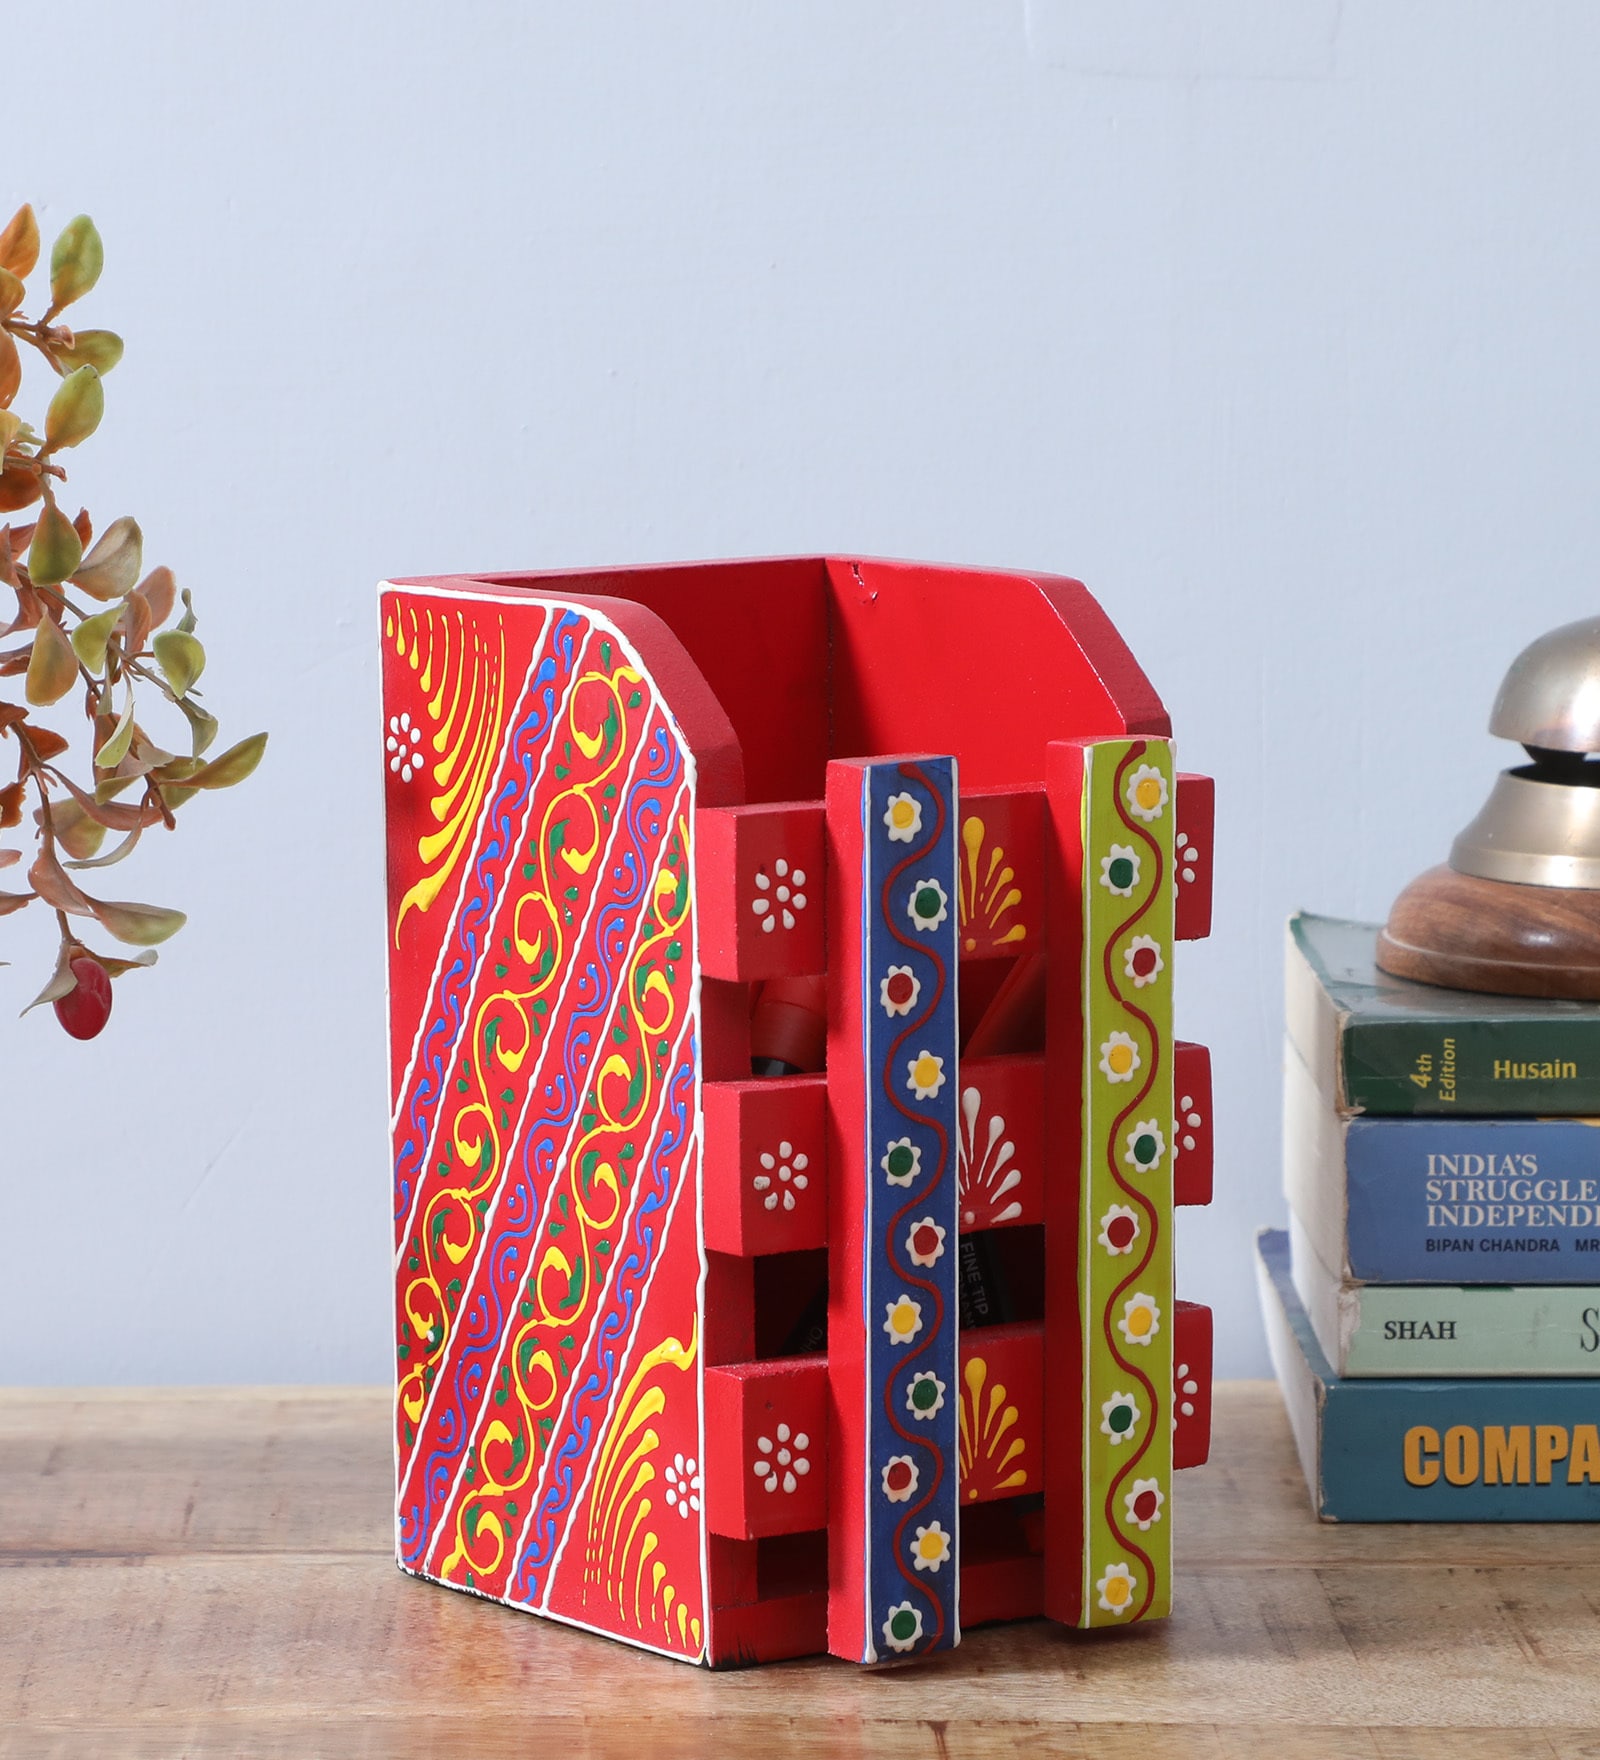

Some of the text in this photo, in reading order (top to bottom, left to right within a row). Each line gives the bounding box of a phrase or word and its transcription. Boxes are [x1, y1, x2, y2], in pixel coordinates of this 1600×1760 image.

[1410, 1053, 1432, 1088] 4th
[1439, 1038, 1456, 1101] Edition
[1494, 1059, 1577, 1080] Husain
[1426, 1154, 1539, 1176] INDIA'S
[1425, 1179, 1599, 1201] STRUGGLE
[1426, 1239, 1474, 1251] BIPAN
[1479, 1238, 1560, 1251] CHANDRA
[960, 1241, 981, 1284] FINE
[972, 1285, 989, 1315] TIP
[1384, 1320, 1457, 1340] SHAH
[1580, 1307, 1600, 1352] S
[1403, 1424, 1600, 1487] COMPA
